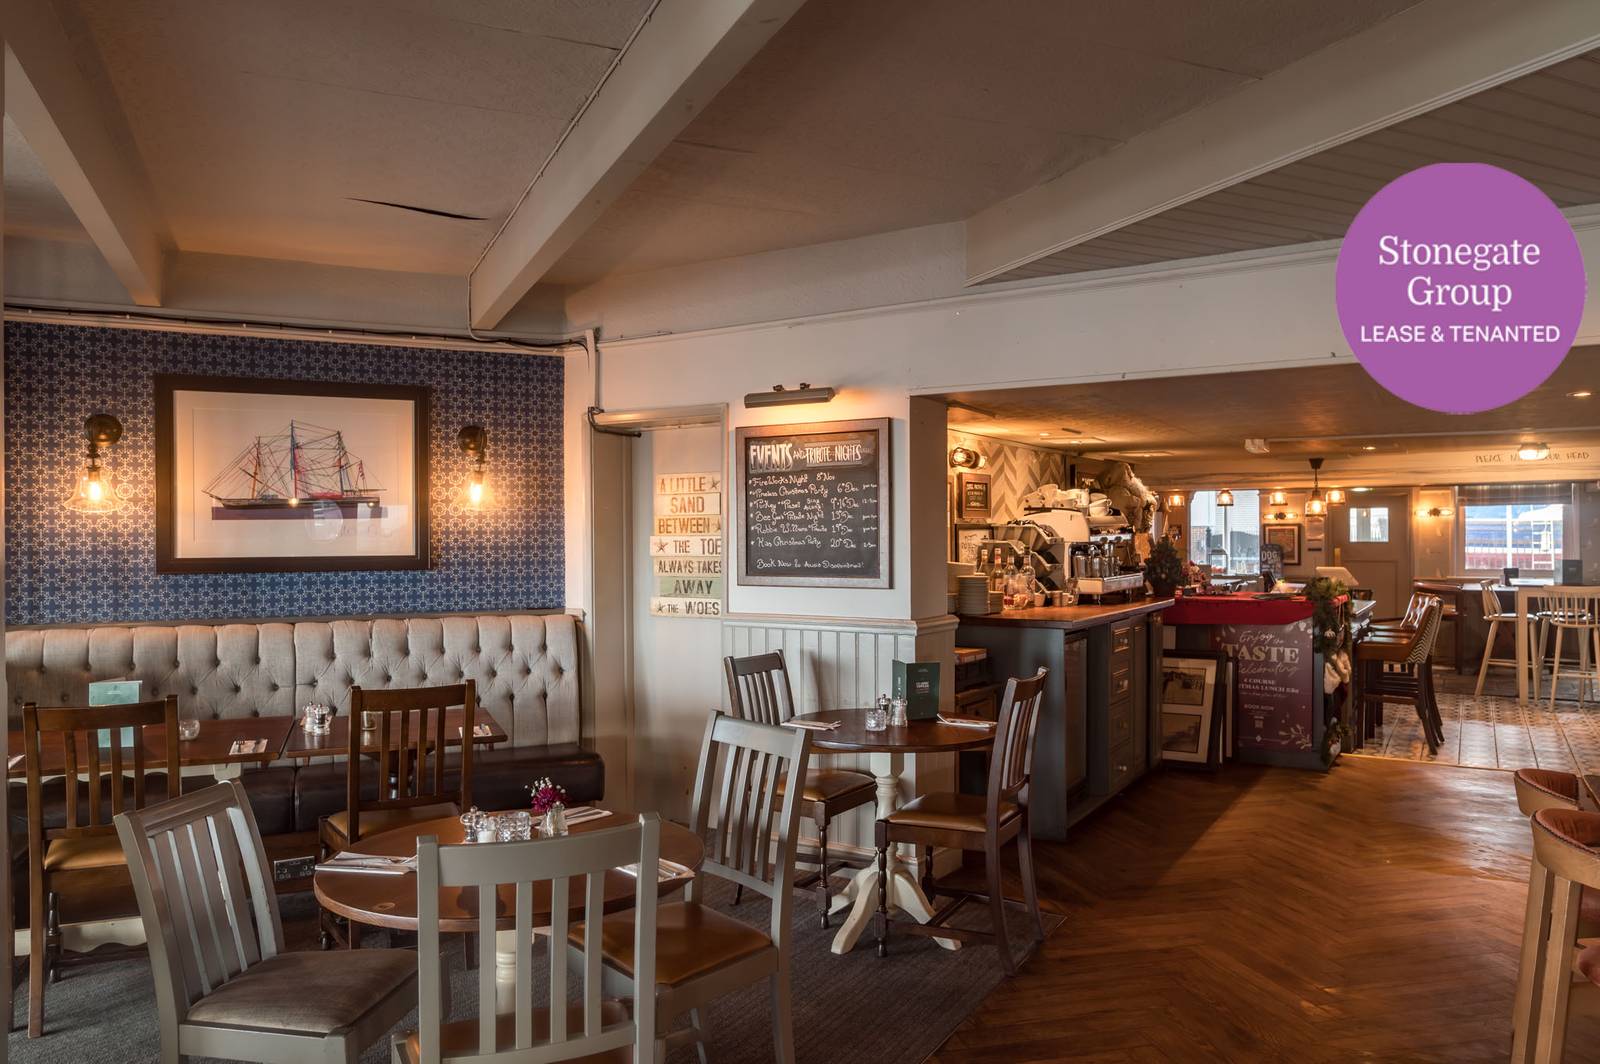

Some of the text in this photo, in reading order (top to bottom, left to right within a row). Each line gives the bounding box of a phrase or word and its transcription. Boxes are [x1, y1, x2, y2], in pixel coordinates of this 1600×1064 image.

[749, 443, 793, 470] EVENTS
[805, 446, 831, 463] TRIBUTE
[834, 444, 862, 462] NIGHTS
[660, 476, 706, 493] A LITTLE
[844, 482, 860, 493] Dec
[670, 496, 705, 513] SAND
[658, 517, 710, 534] BETWEEN
[673, 538, 721, 555] THE TOE
[658, 560, 694, 574] ALWAYS
[756, 558, 777, 570] Book
[778, 559, 792, 568] Now
[673, 579, 713, 595] AWAY
[667, 601, 720, 615] THE WOES
[1239, 630, 1275, 646] Enjoy
[1221, 643, 1300, 664] TASTE
